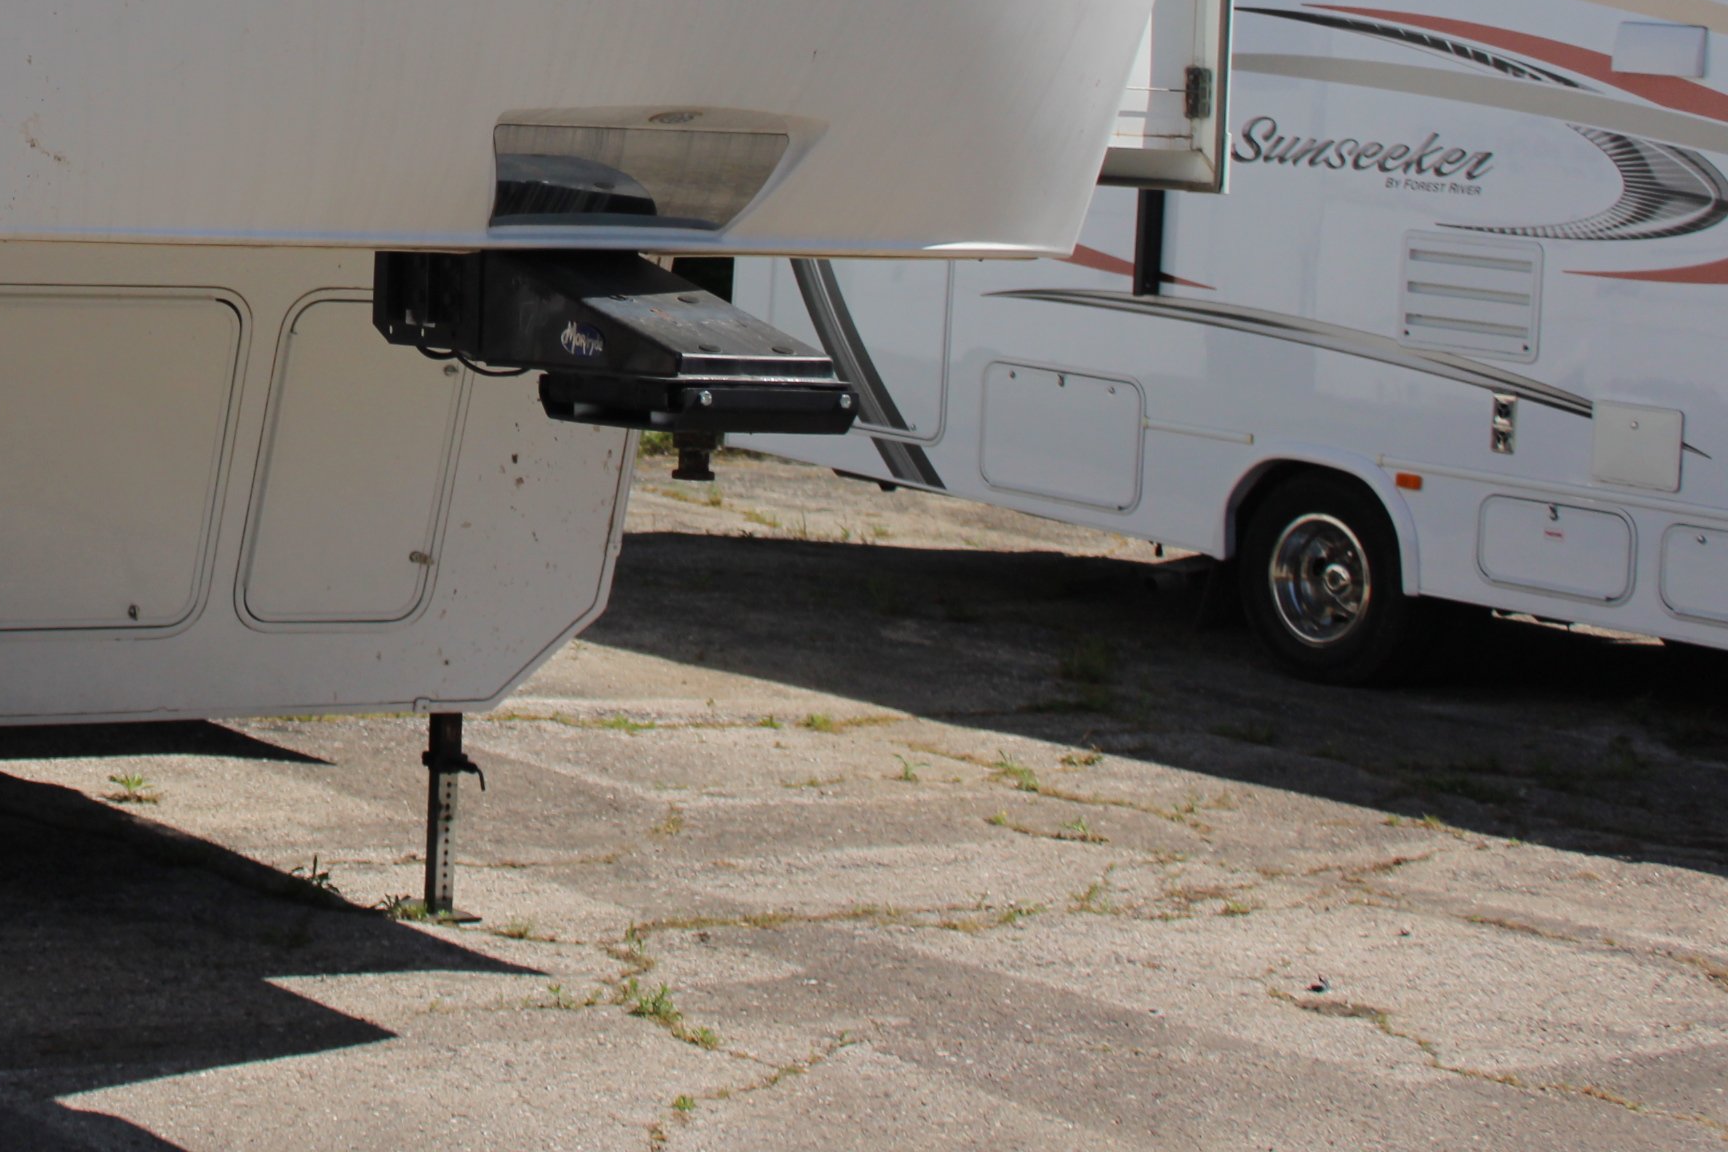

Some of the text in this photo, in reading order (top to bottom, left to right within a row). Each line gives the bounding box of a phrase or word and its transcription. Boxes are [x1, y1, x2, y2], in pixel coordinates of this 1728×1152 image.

[1231, 116, 1494, 180] Sunseeker
[1403, 179, 1447, 193] FOREST
[1449, 182, 1481, 195] RIVER
